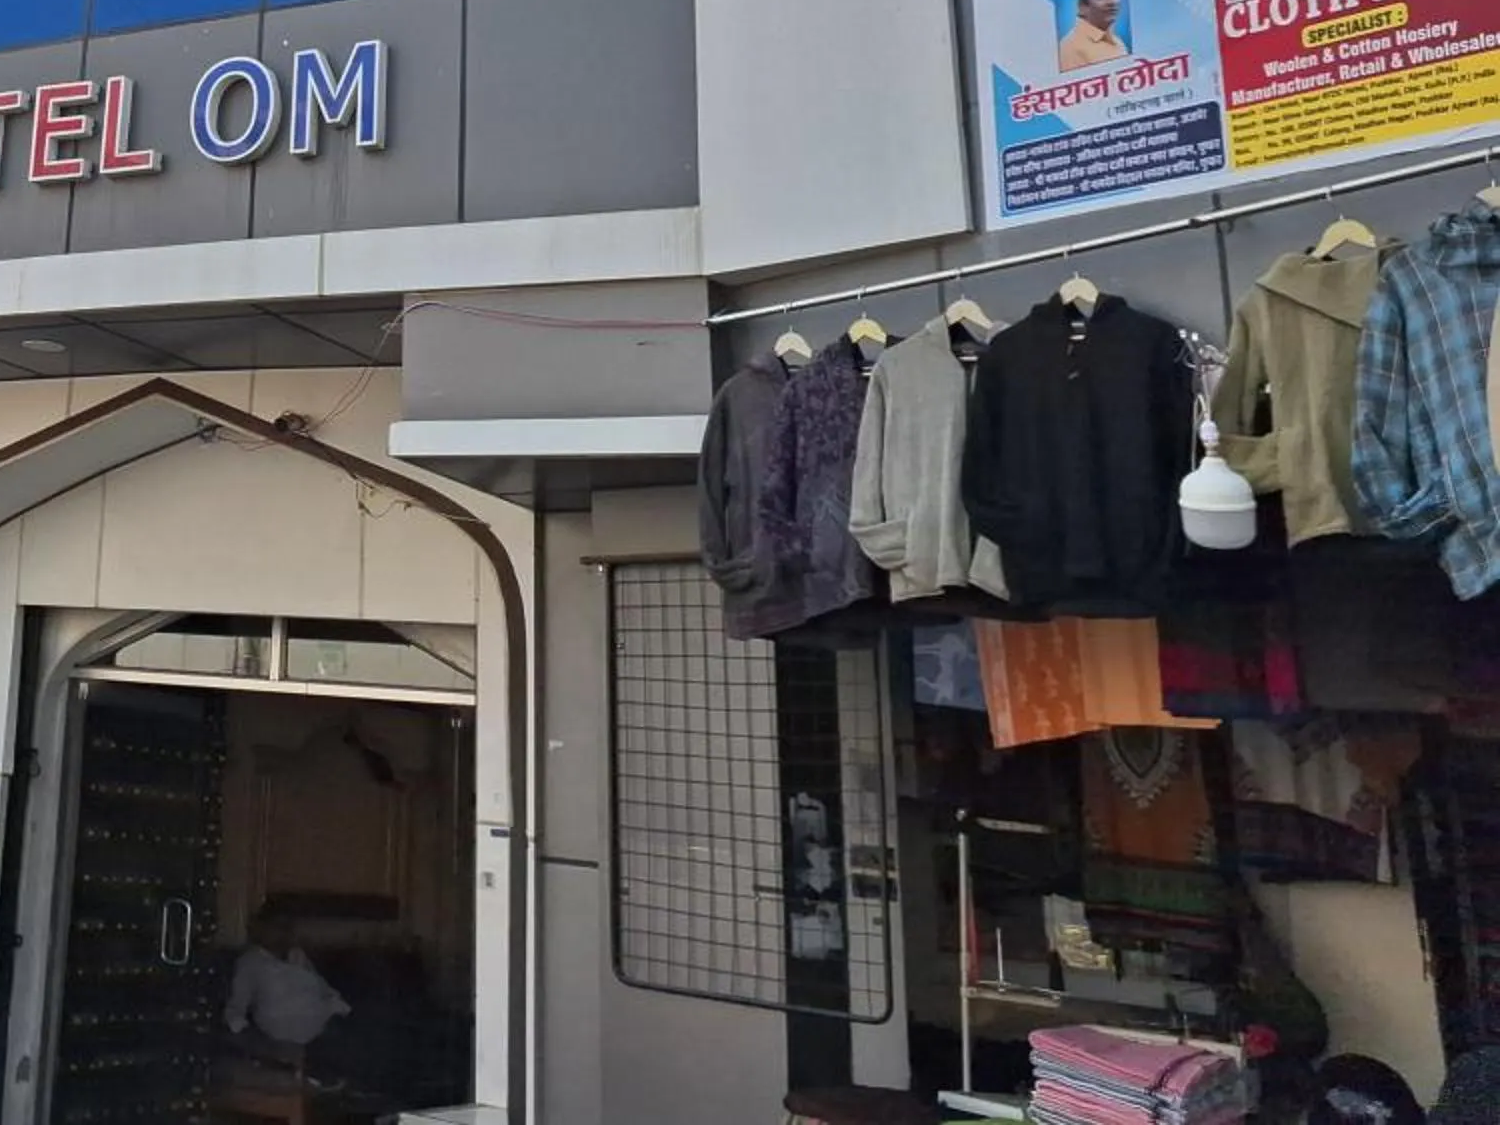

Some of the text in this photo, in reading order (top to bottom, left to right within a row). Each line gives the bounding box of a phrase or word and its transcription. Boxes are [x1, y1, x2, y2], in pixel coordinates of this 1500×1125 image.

[1263, 19, 1458, 78] Woolen & Cotton Hosiery
[1308, 10, 1393, 44] SPECIALIST
[1339, 56, 1386, 80] Retail
[1390, 52, 1404, 69] &
[190, 40, 389, 167] OM
[1010, 74, 1110, 121] हंसराज
